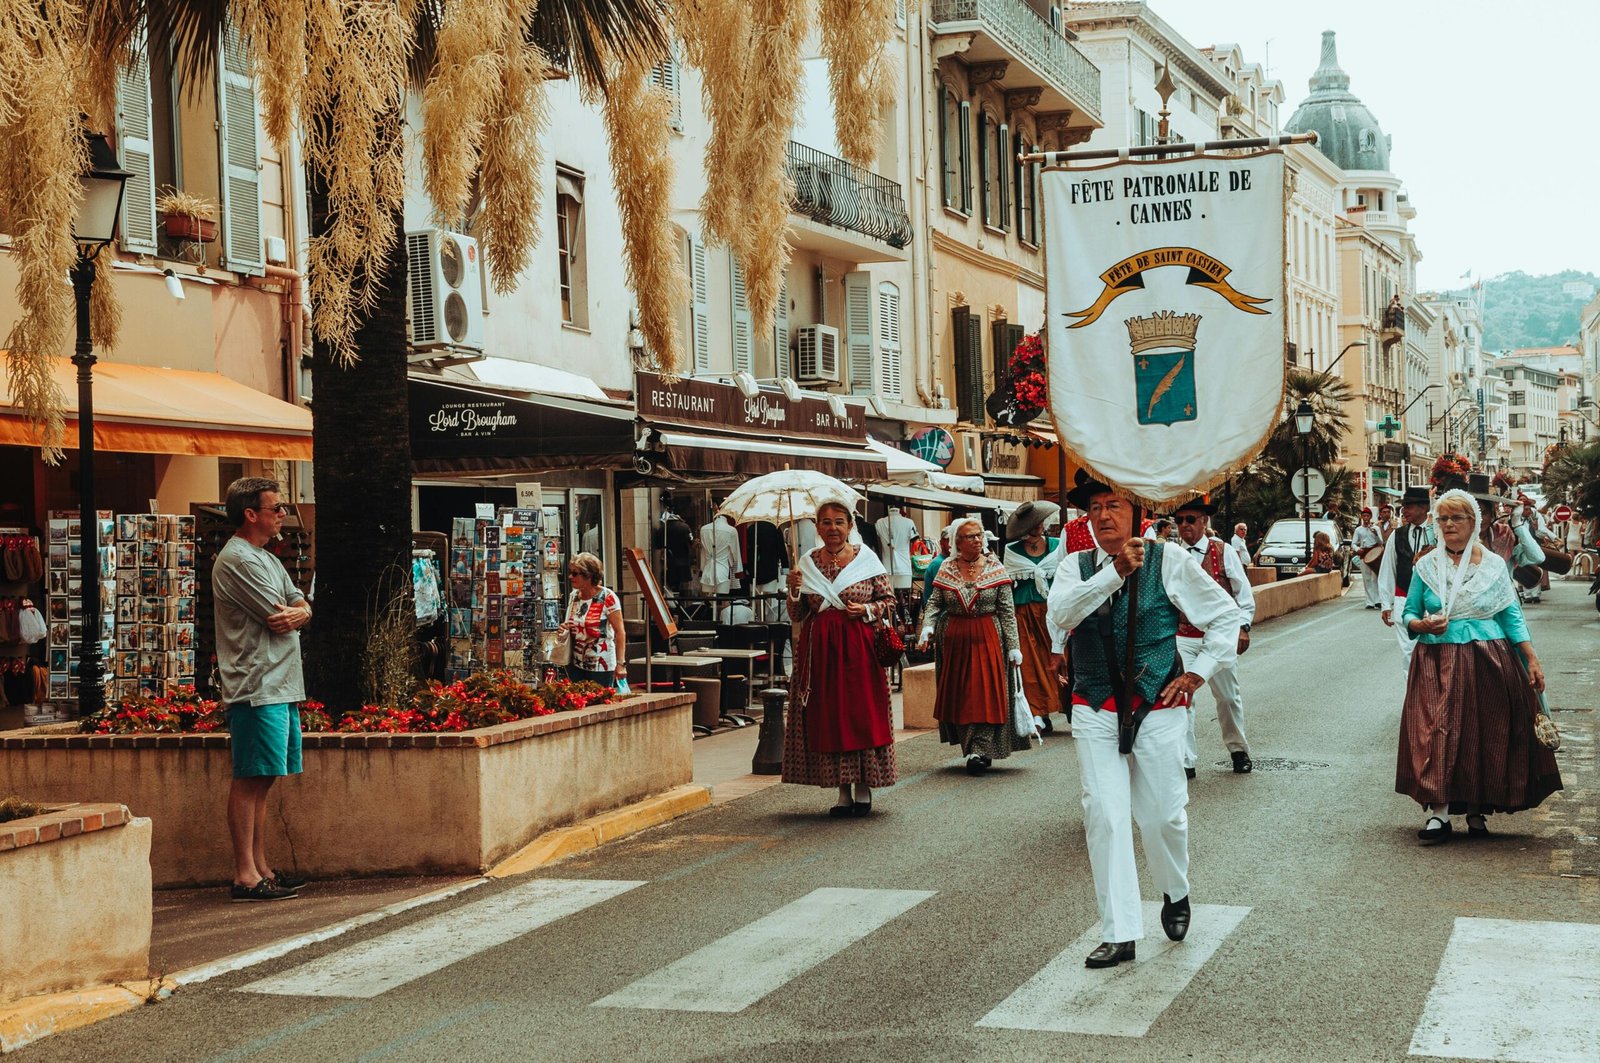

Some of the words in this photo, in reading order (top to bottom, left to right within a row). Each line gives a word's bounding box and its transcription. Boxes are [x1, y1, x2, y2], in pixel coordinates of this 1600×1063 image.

[1071, 179, 1114, 204] FÊTE
[1123, 171, 1219, 198] PATRONALE
[1229, 169, 1251, 192] DE
[1130, 199, 1192, 225] CANNES
[1108, 262, 1133, 283] FÊTE
[1136, 255, 1150, 269] DE
[1154, 250, 1183, 264] SAINT
[1186, 251, 1225, 277] CASSIEN
[652, 390, 715, 413] RESTAURANT
[429, 410, 459, 432] Lord
[461, 409, 517, 431] Brougham
[816, 412, 830, 427] BAR
[841, 416, 853, 429] VIN
